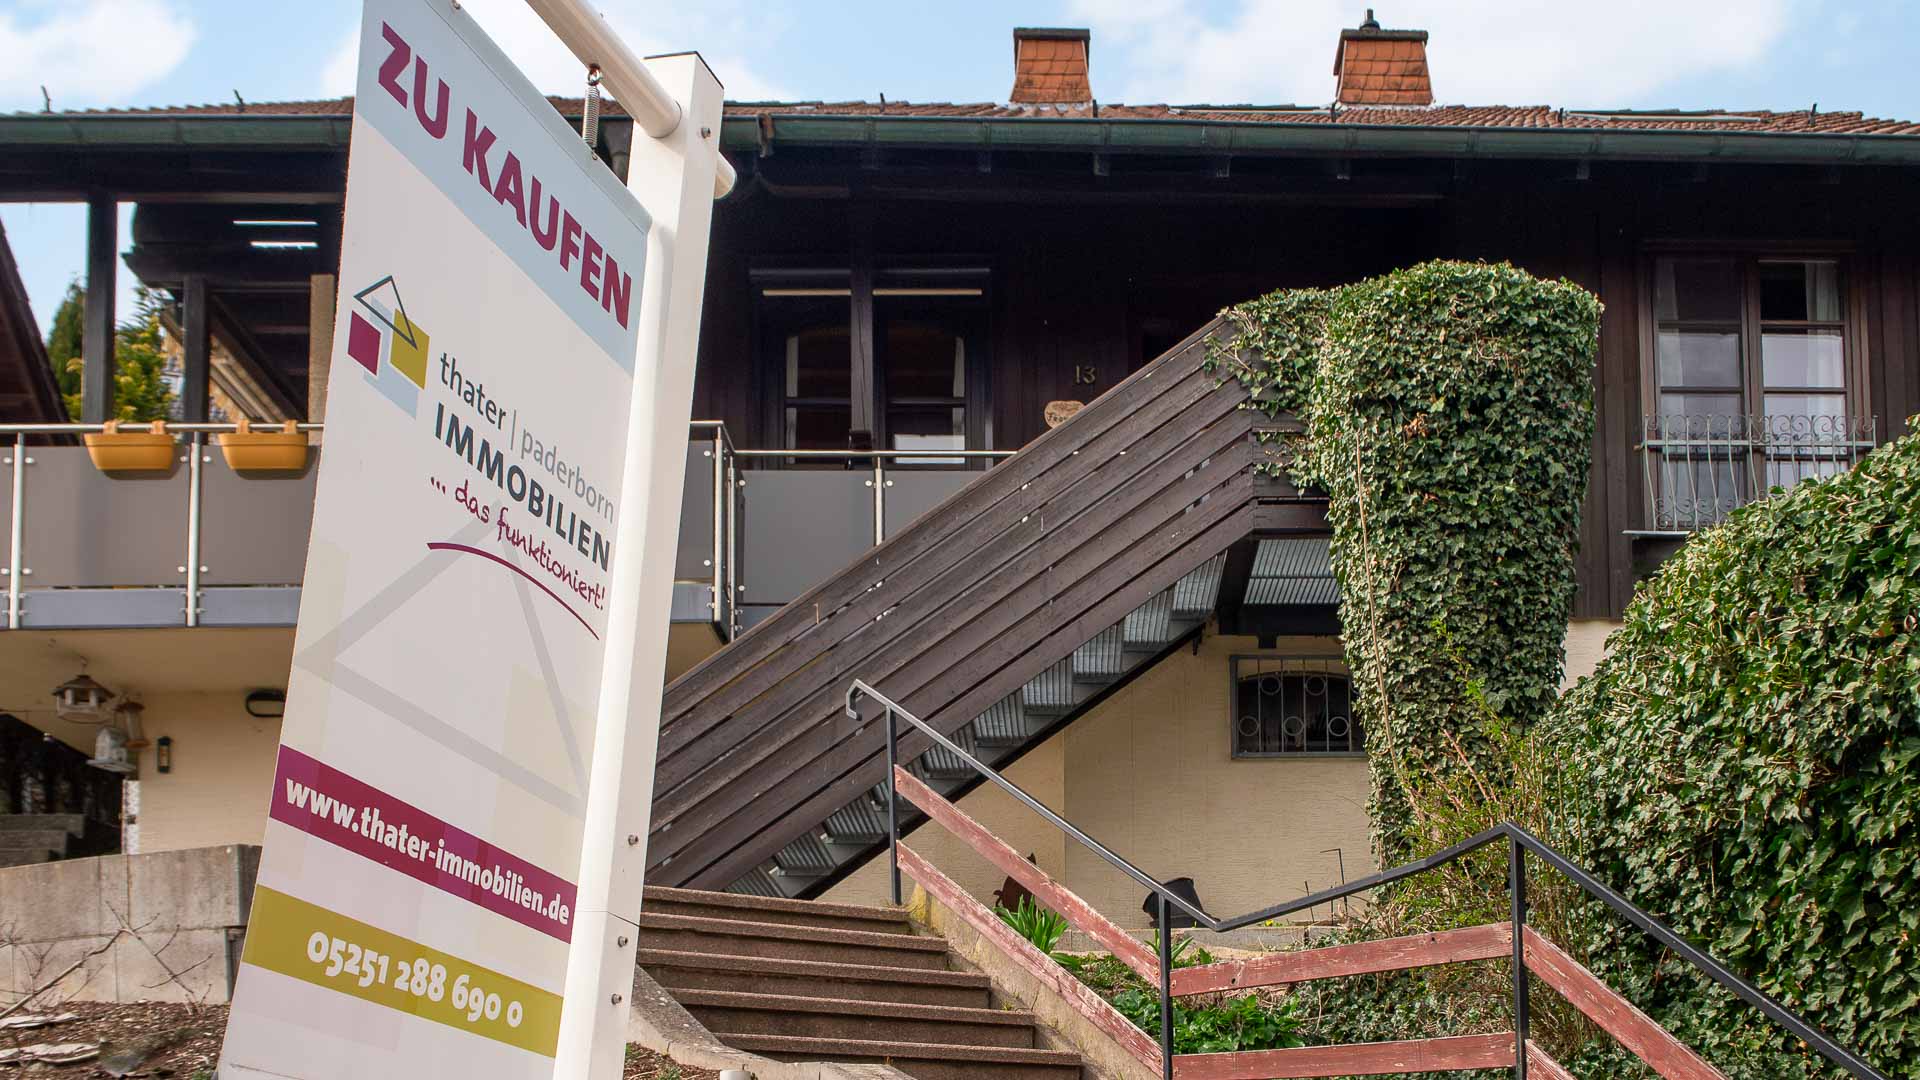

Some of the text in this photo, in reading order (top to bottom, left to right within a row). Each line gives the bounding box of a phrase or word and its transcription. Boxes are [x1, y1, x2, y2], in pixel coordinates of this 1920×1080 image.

[378, 20, 632, 331] ZU KAUFEN
[440, 352, 615, 525] thater paderborn
[1075, 364, 1096, 384] 13
[434, 402, 611, 573] IMMOBILIEN
[454, 479, 490, 524] das
[496, 506, 605, 611] funktioniert!
[285, 777, 570, 926] www.thater-immobilien.de
[306, 931, 390, 988] 05251
[394, 957, 447, 1002] 288
[452, 973, 501, 1022] 690
